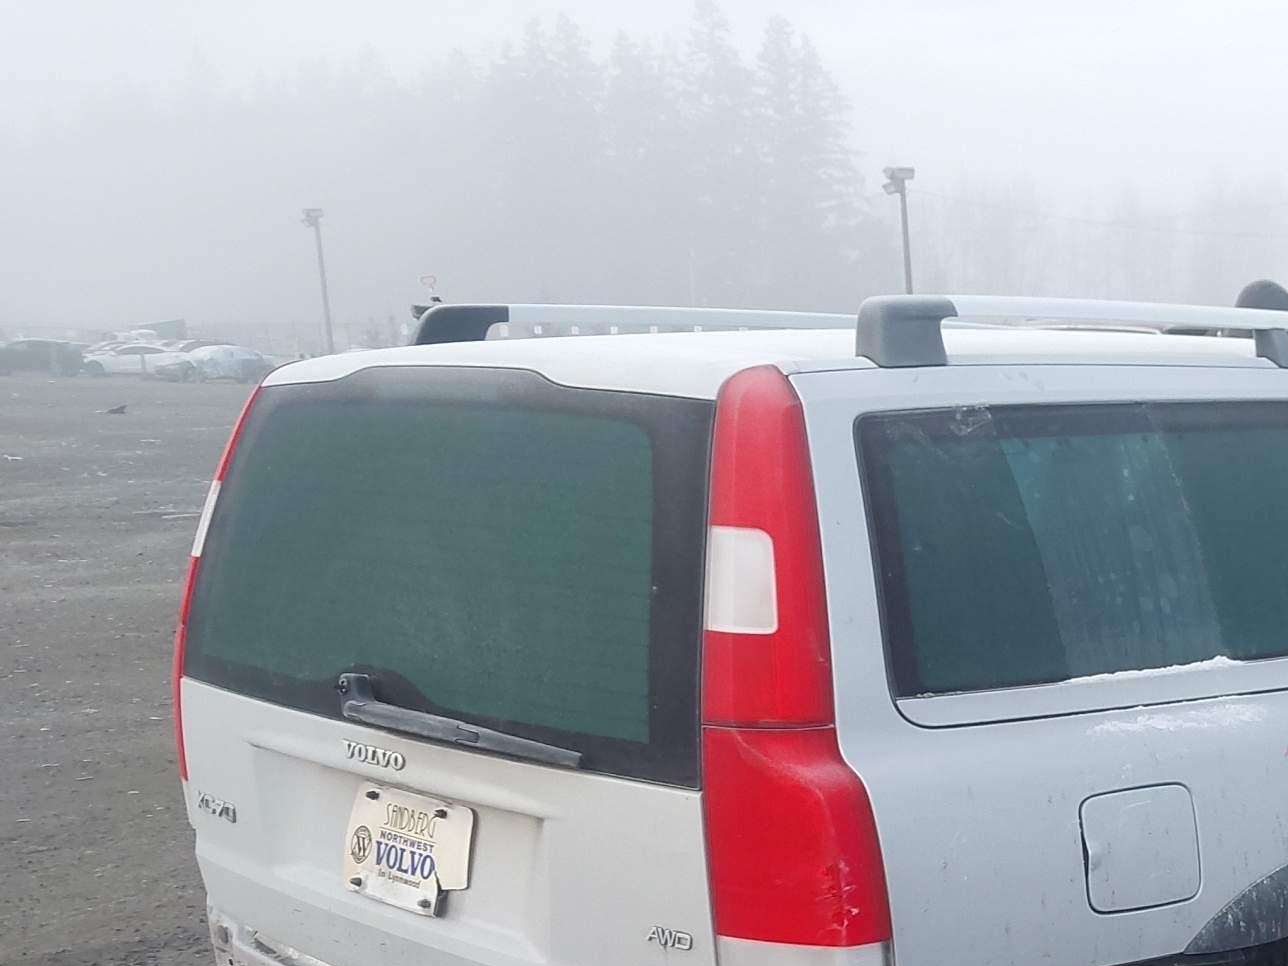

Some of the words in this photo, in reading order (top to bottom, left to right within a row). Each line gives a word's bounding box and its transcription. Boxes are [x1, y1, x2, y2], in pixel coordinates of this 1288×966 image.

[343, 738, 406, 771] VOLVO
[384, 803, 438, 838] SANDBERG
[379, 830, 434, 853] NORTHWEST
[375, 840, 436, 879] VOLVO
[647, 926, 693, 951] AWD
